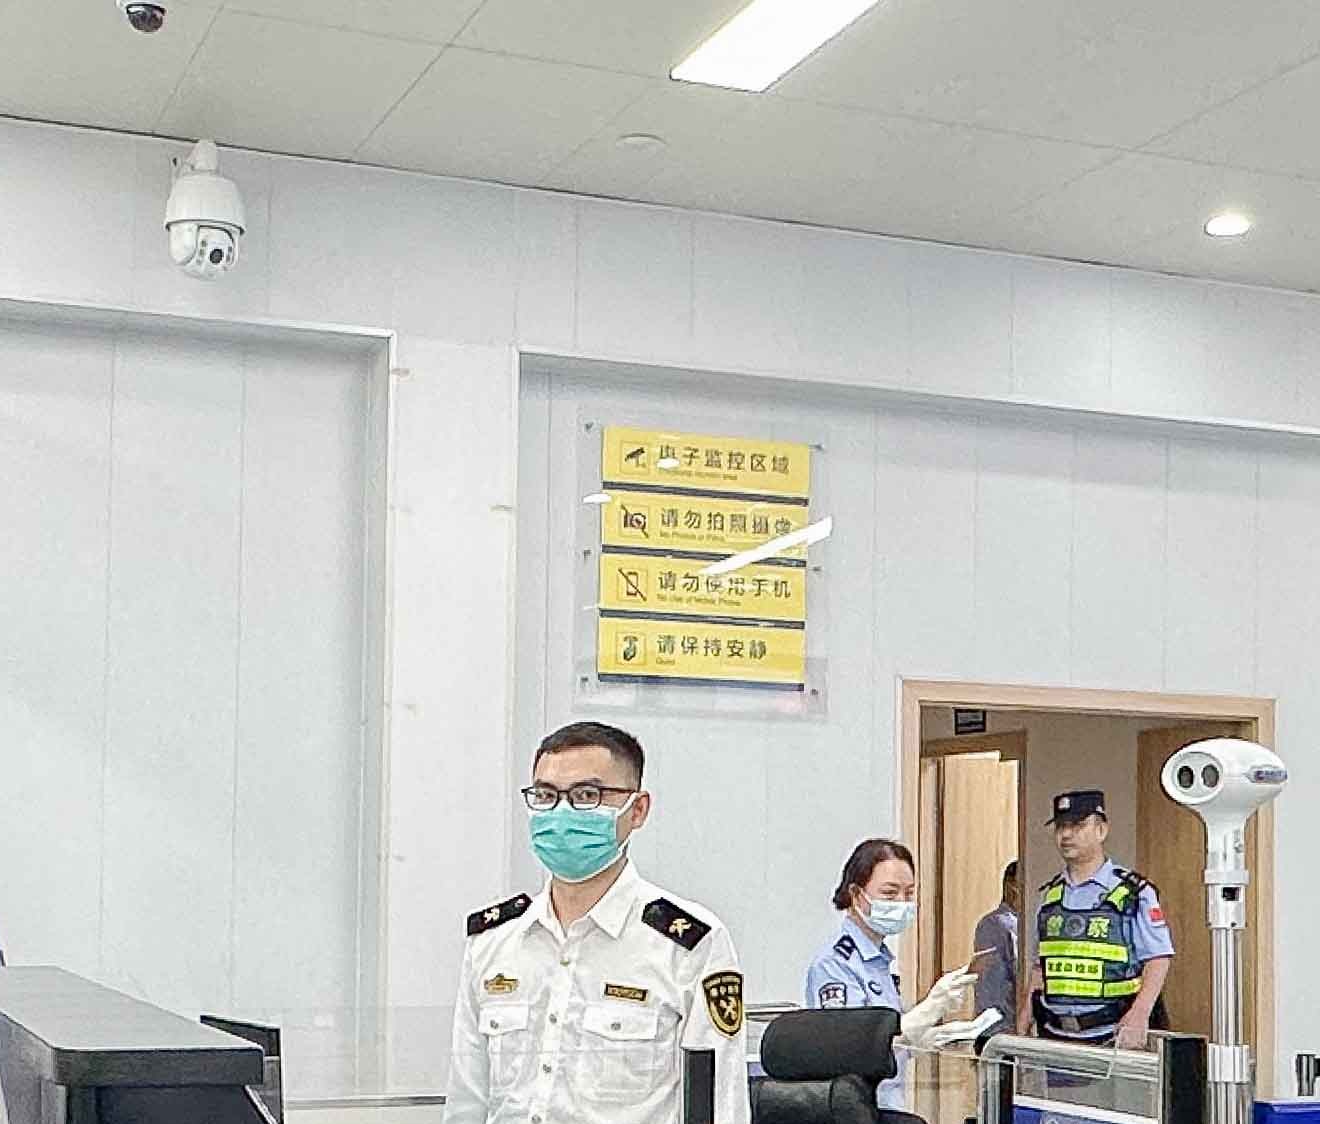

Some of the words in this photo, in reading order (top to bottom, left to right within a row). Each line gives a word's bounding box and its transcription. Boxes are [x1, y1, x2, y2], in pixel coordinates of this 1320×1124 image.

[656, 634, 768, 660] 请保持安静
